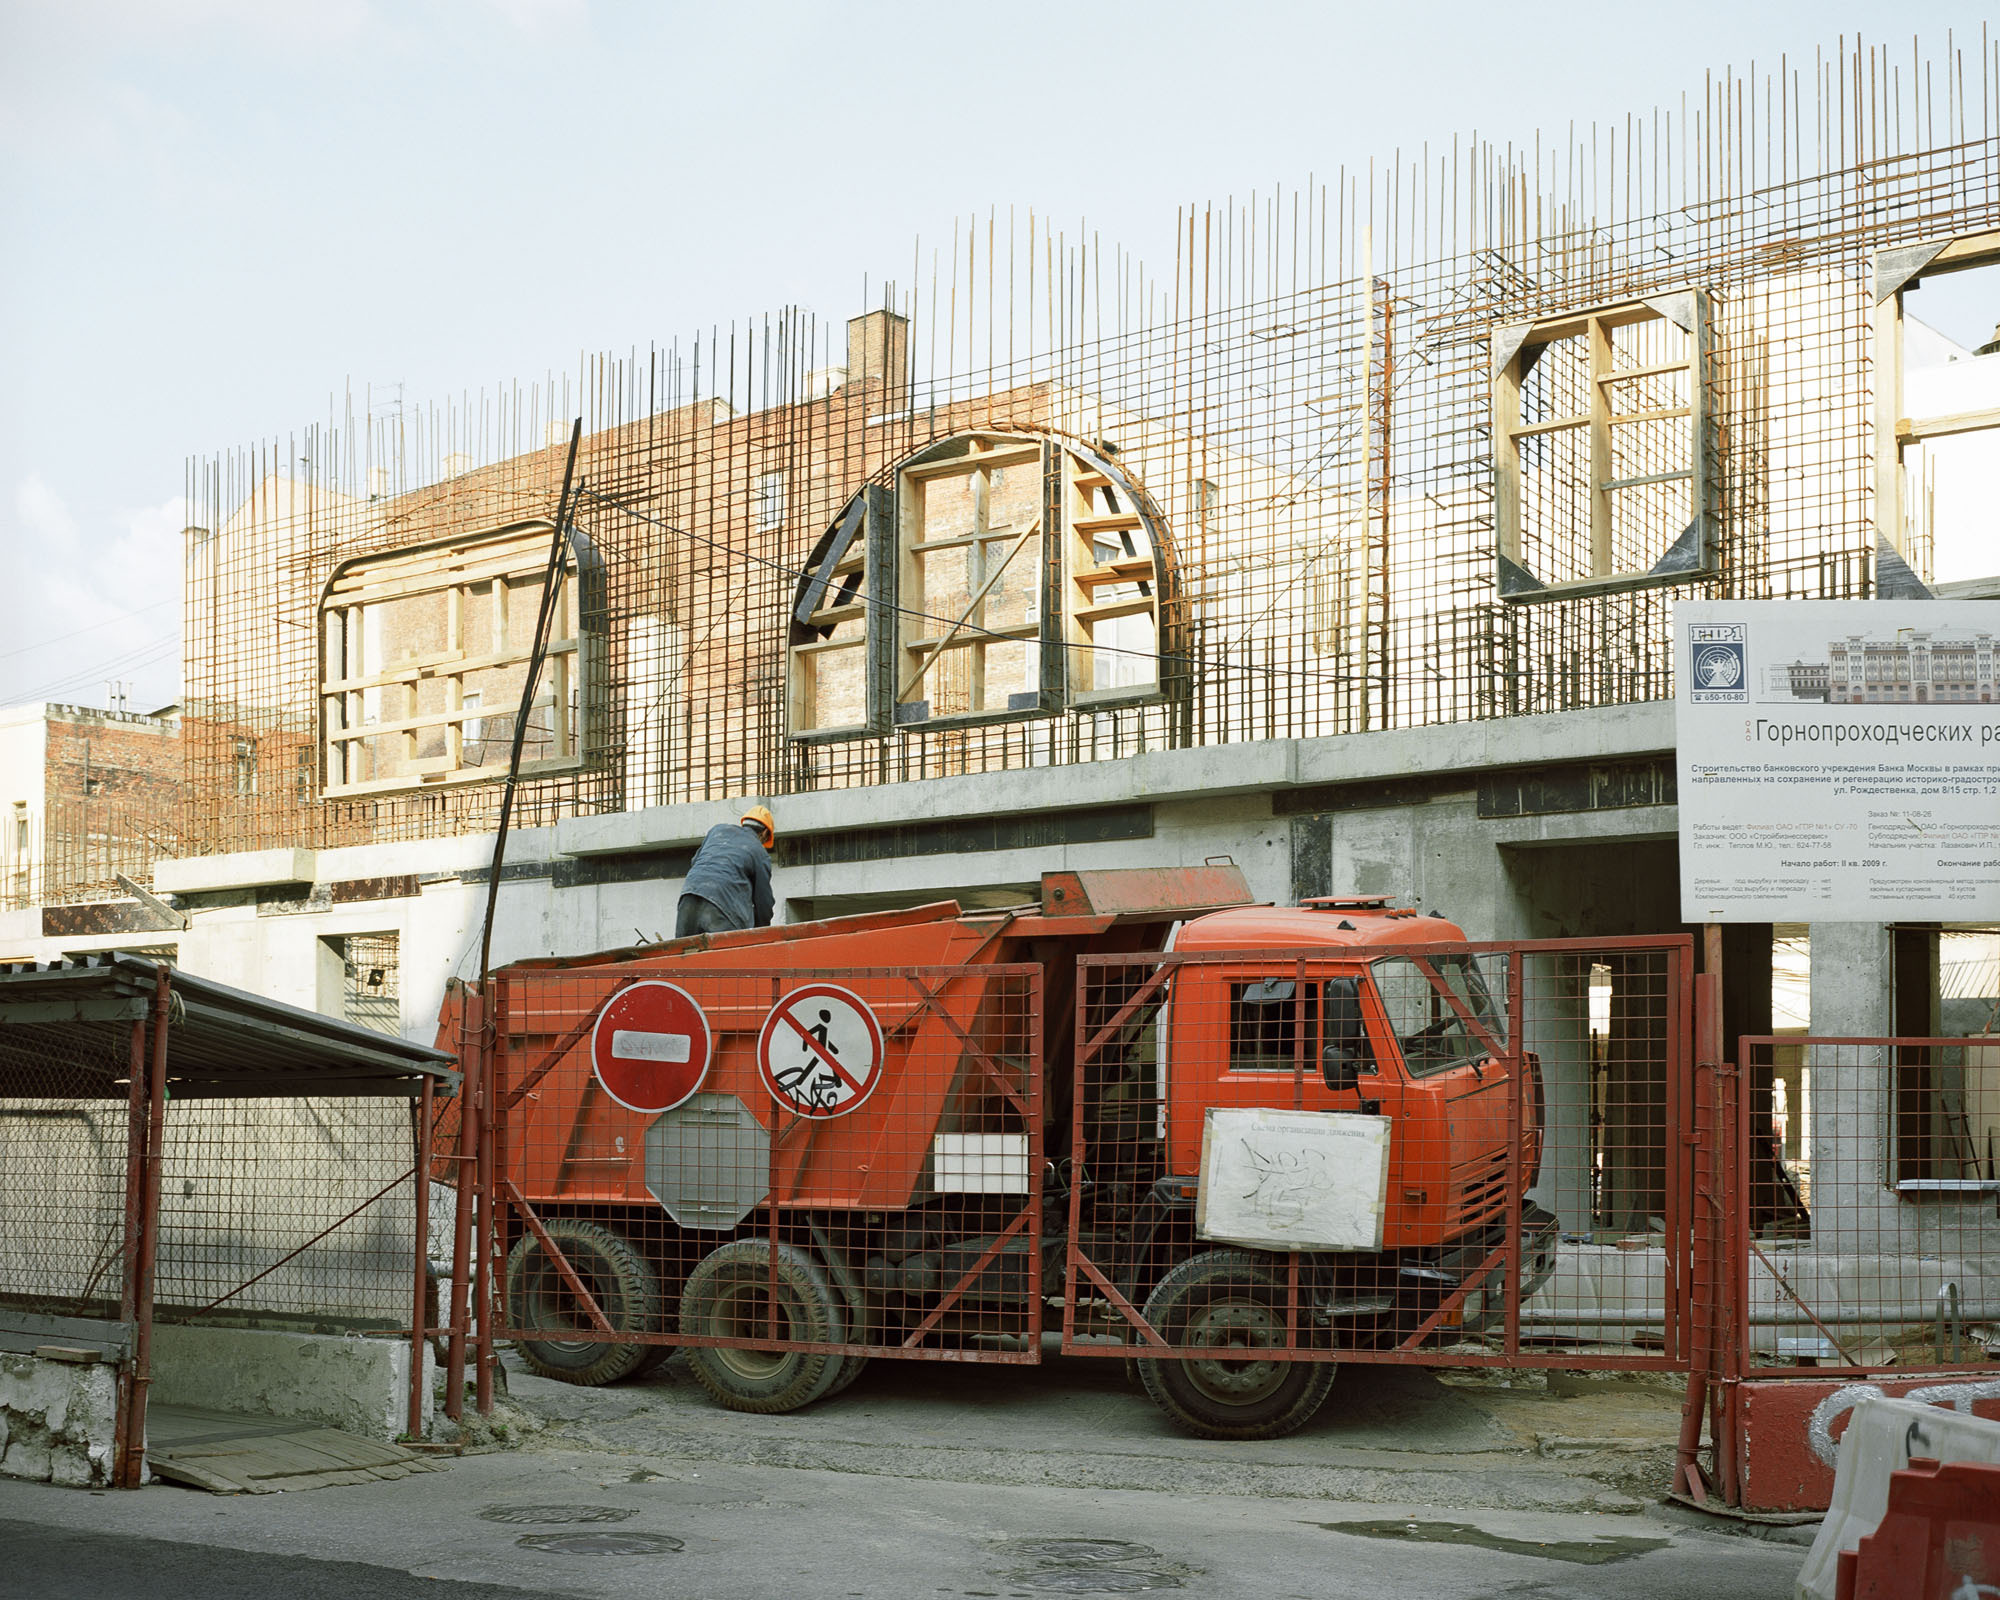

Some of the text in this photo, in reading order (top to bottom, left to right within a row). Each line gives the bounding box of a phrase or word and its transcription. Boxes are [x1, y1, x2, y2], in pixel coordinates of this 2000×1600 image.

[1704, 693, 1745, 701] 650-10-80
[1756, 718, 1974, 746] Горнопроходческих
[1691, 764, 1762, 773] Строительство
[1763, 763, 1820, 773] банковского
[1821, 764, 1876, 774] учреждения
[1878, 763, 1905, 773] Банка
[1906, 763, 1943, 773] Москвы
[1952, 765, 1985, 774] рамках
[1691, 776, 1762, 785] направленных
[1763, 775, 1776, 783] на
[1777, 775, 1832, 785] сохранение
[1834, 775, 1841, 783] и
[1842, 775, 1904, 785] регенерацию
[1833, 784, 1997, 796] ул. Рождественка, дом 8/15 стр. 1,2
[1867, 810, 1889, 818] Заказ
[1692, 823, 1720, 831] Работы
[1775, 823, 1794, 831] ОАО
[1921, 823, 1938, 831] ОАО
[1729, 832, 1748, 840] ООО
[1952, 832, 1969, 840] ОАО
[1727, 841, 1755, 849] Теплов
[1780, 859, 1812, 868] Начало
[1812, 859, 1840, 869] работ:
[1848, 860, 1861, 868] кв.
[1862, 859, 1881, 868] 2009
[1936, 859, 1982, 868] Окончание
